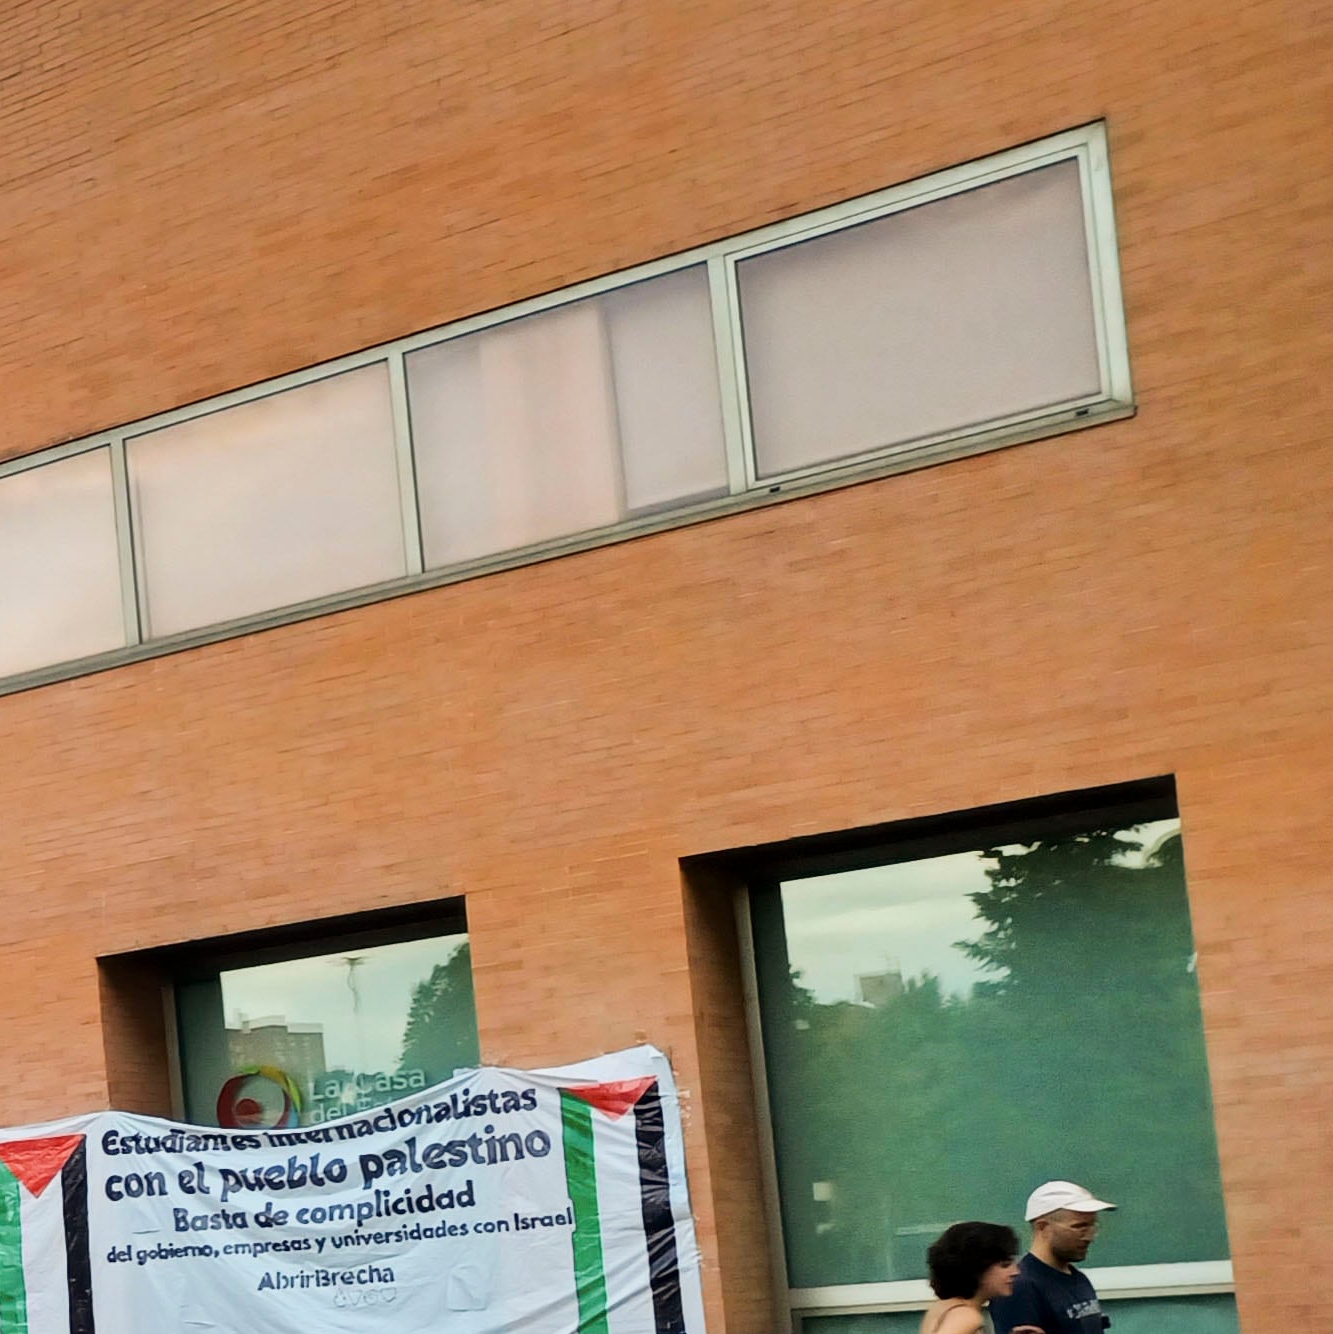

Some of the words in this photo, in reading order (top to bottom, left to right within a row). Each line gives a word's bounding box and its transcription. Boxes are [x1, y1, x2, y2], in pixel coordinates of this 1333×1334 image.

[308, 1079, 341, 1101] La
[353, 1068, 425, 1095] Casa
[105, 1171, 168, 1201] con
[178, 1161, 210, 1195] el
[218, 1152, 348, 1202] pueblo
[359, 1124, 551, 1190] palestino
[172, 1207, 249, 1232] Basta
[254, 1202, 289, 1228] de
[296, 1180, 476, 1227] complicidad
[106, 1245, 132, 1263] del
[136, 1243, 220, 1266] gobierno,
[223, 1238, 312, 1257] empresas
[315, 1237, 326, 1253] y
[331, 1220, 469, 1249] universidades
[473, 1217, 510, 1234] con
[514, 1207, 573, 1231] Israel
